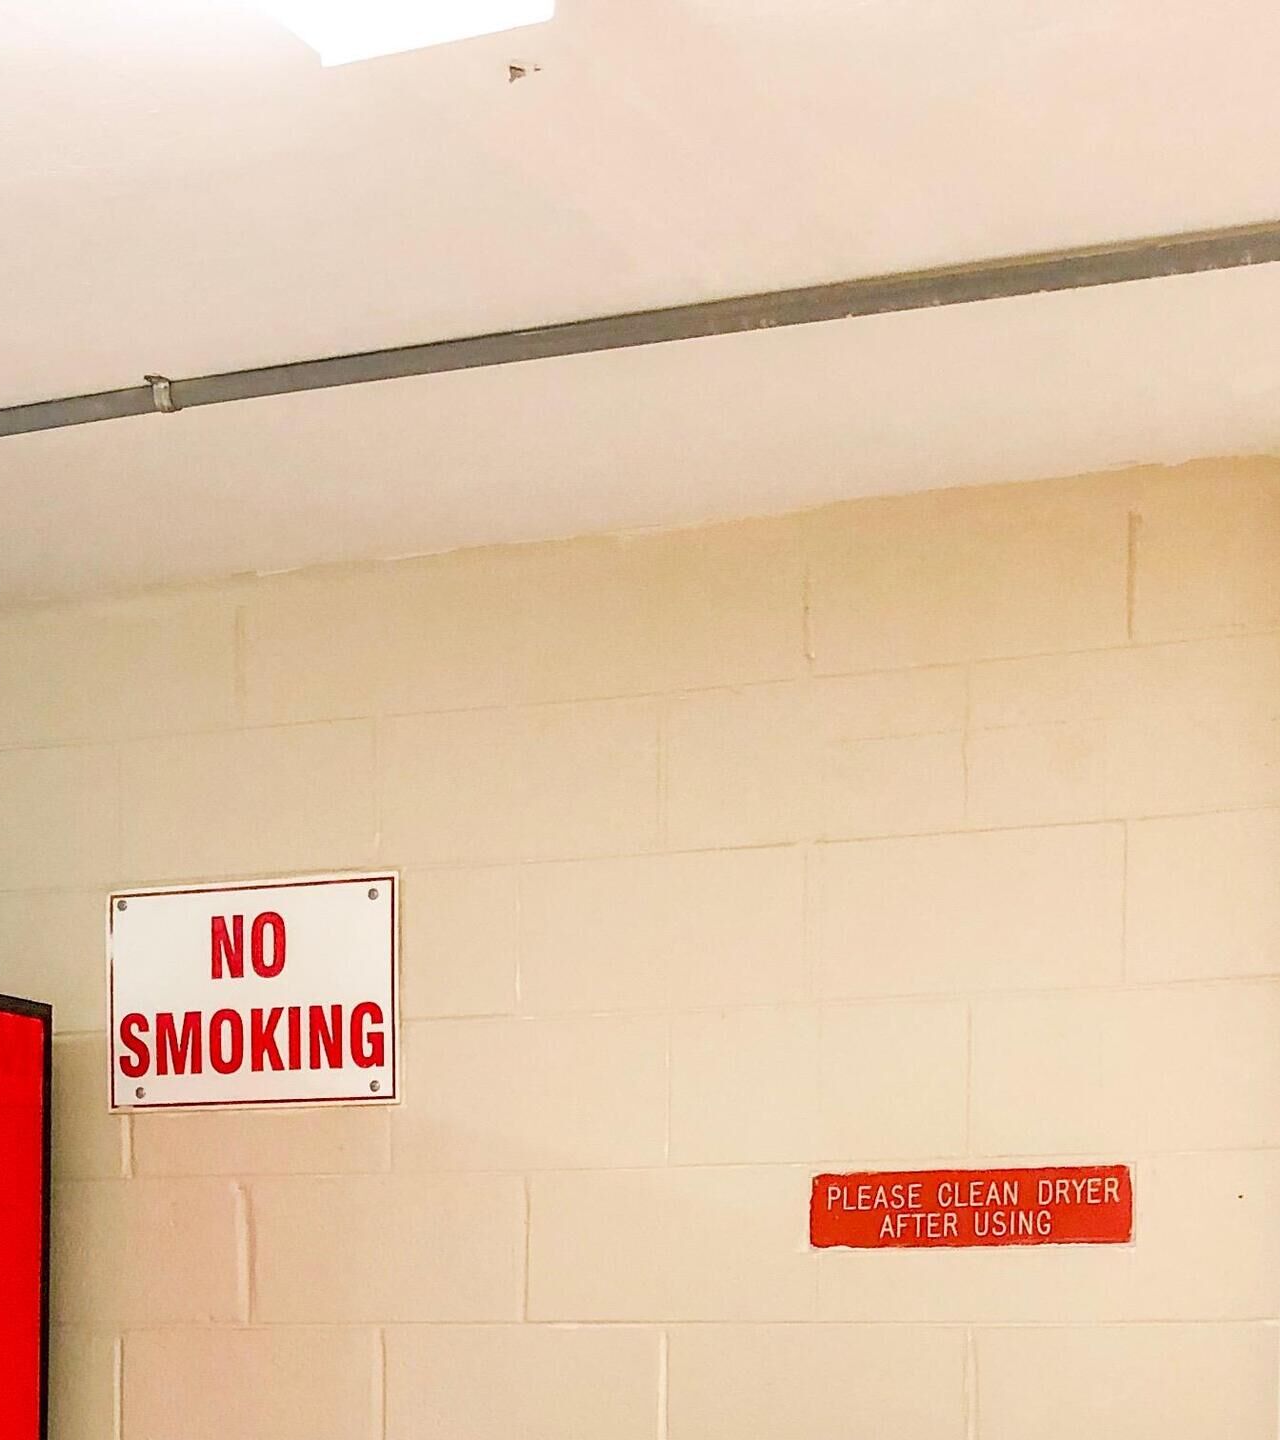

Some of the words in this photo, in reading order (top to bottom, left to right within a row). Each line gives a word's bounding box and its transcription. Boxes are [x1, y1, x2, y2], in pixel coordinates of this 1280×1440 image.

[211, 911, 286, 979] NO
[119, 1001, 385, 1078] SMOKING
[827, 1184, 923, 1211] PLEASE
[937, 1181, 1019, 1207] CLEAN
[1038, 1177, 1121, 1206] DRYER
[879, 1212, 959, 1239] AFTER
[974, 1210, 1052, 1237] USING
